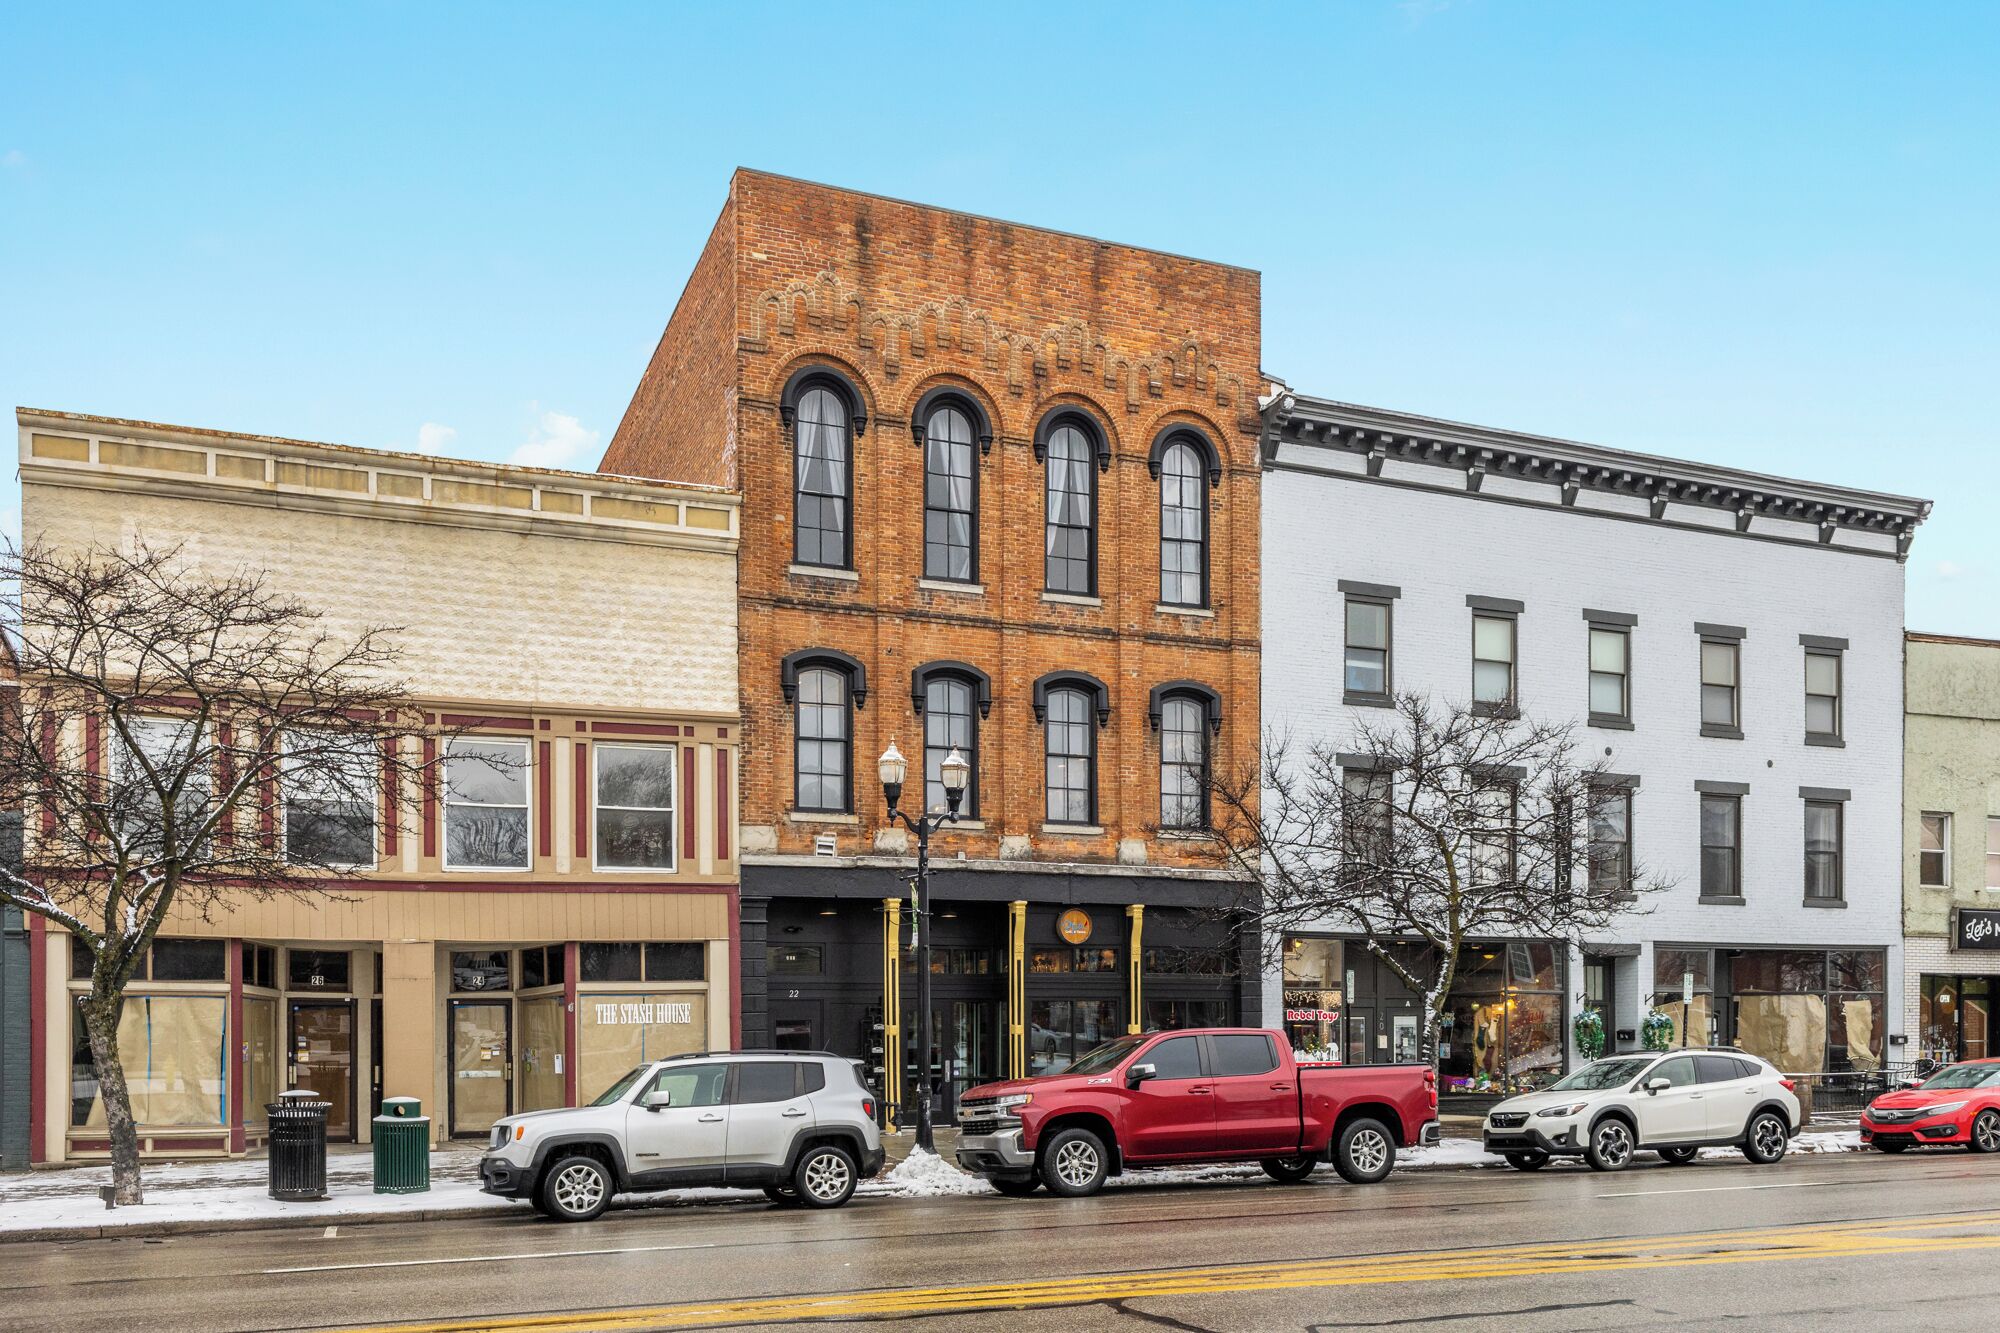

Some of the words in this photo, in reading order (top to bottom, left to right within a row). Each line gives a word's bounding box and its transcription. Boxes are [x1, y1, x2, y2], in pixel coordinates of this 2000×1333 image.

[1965, 918, 1992, 942] Let's
[312, 976, 324, 986] 26
[473, 976, 485, 986] 24
[789, 989, 799, 998] 22
[595, 1003, 618, 1025] THE
[620, 1003, 653, 1024] STASH
[656, 1003, 691, 1024] HOUSE
[1286, 1009, 1315, 1021] Rebel
[1317, 1009, 1339, 1023] Toys
